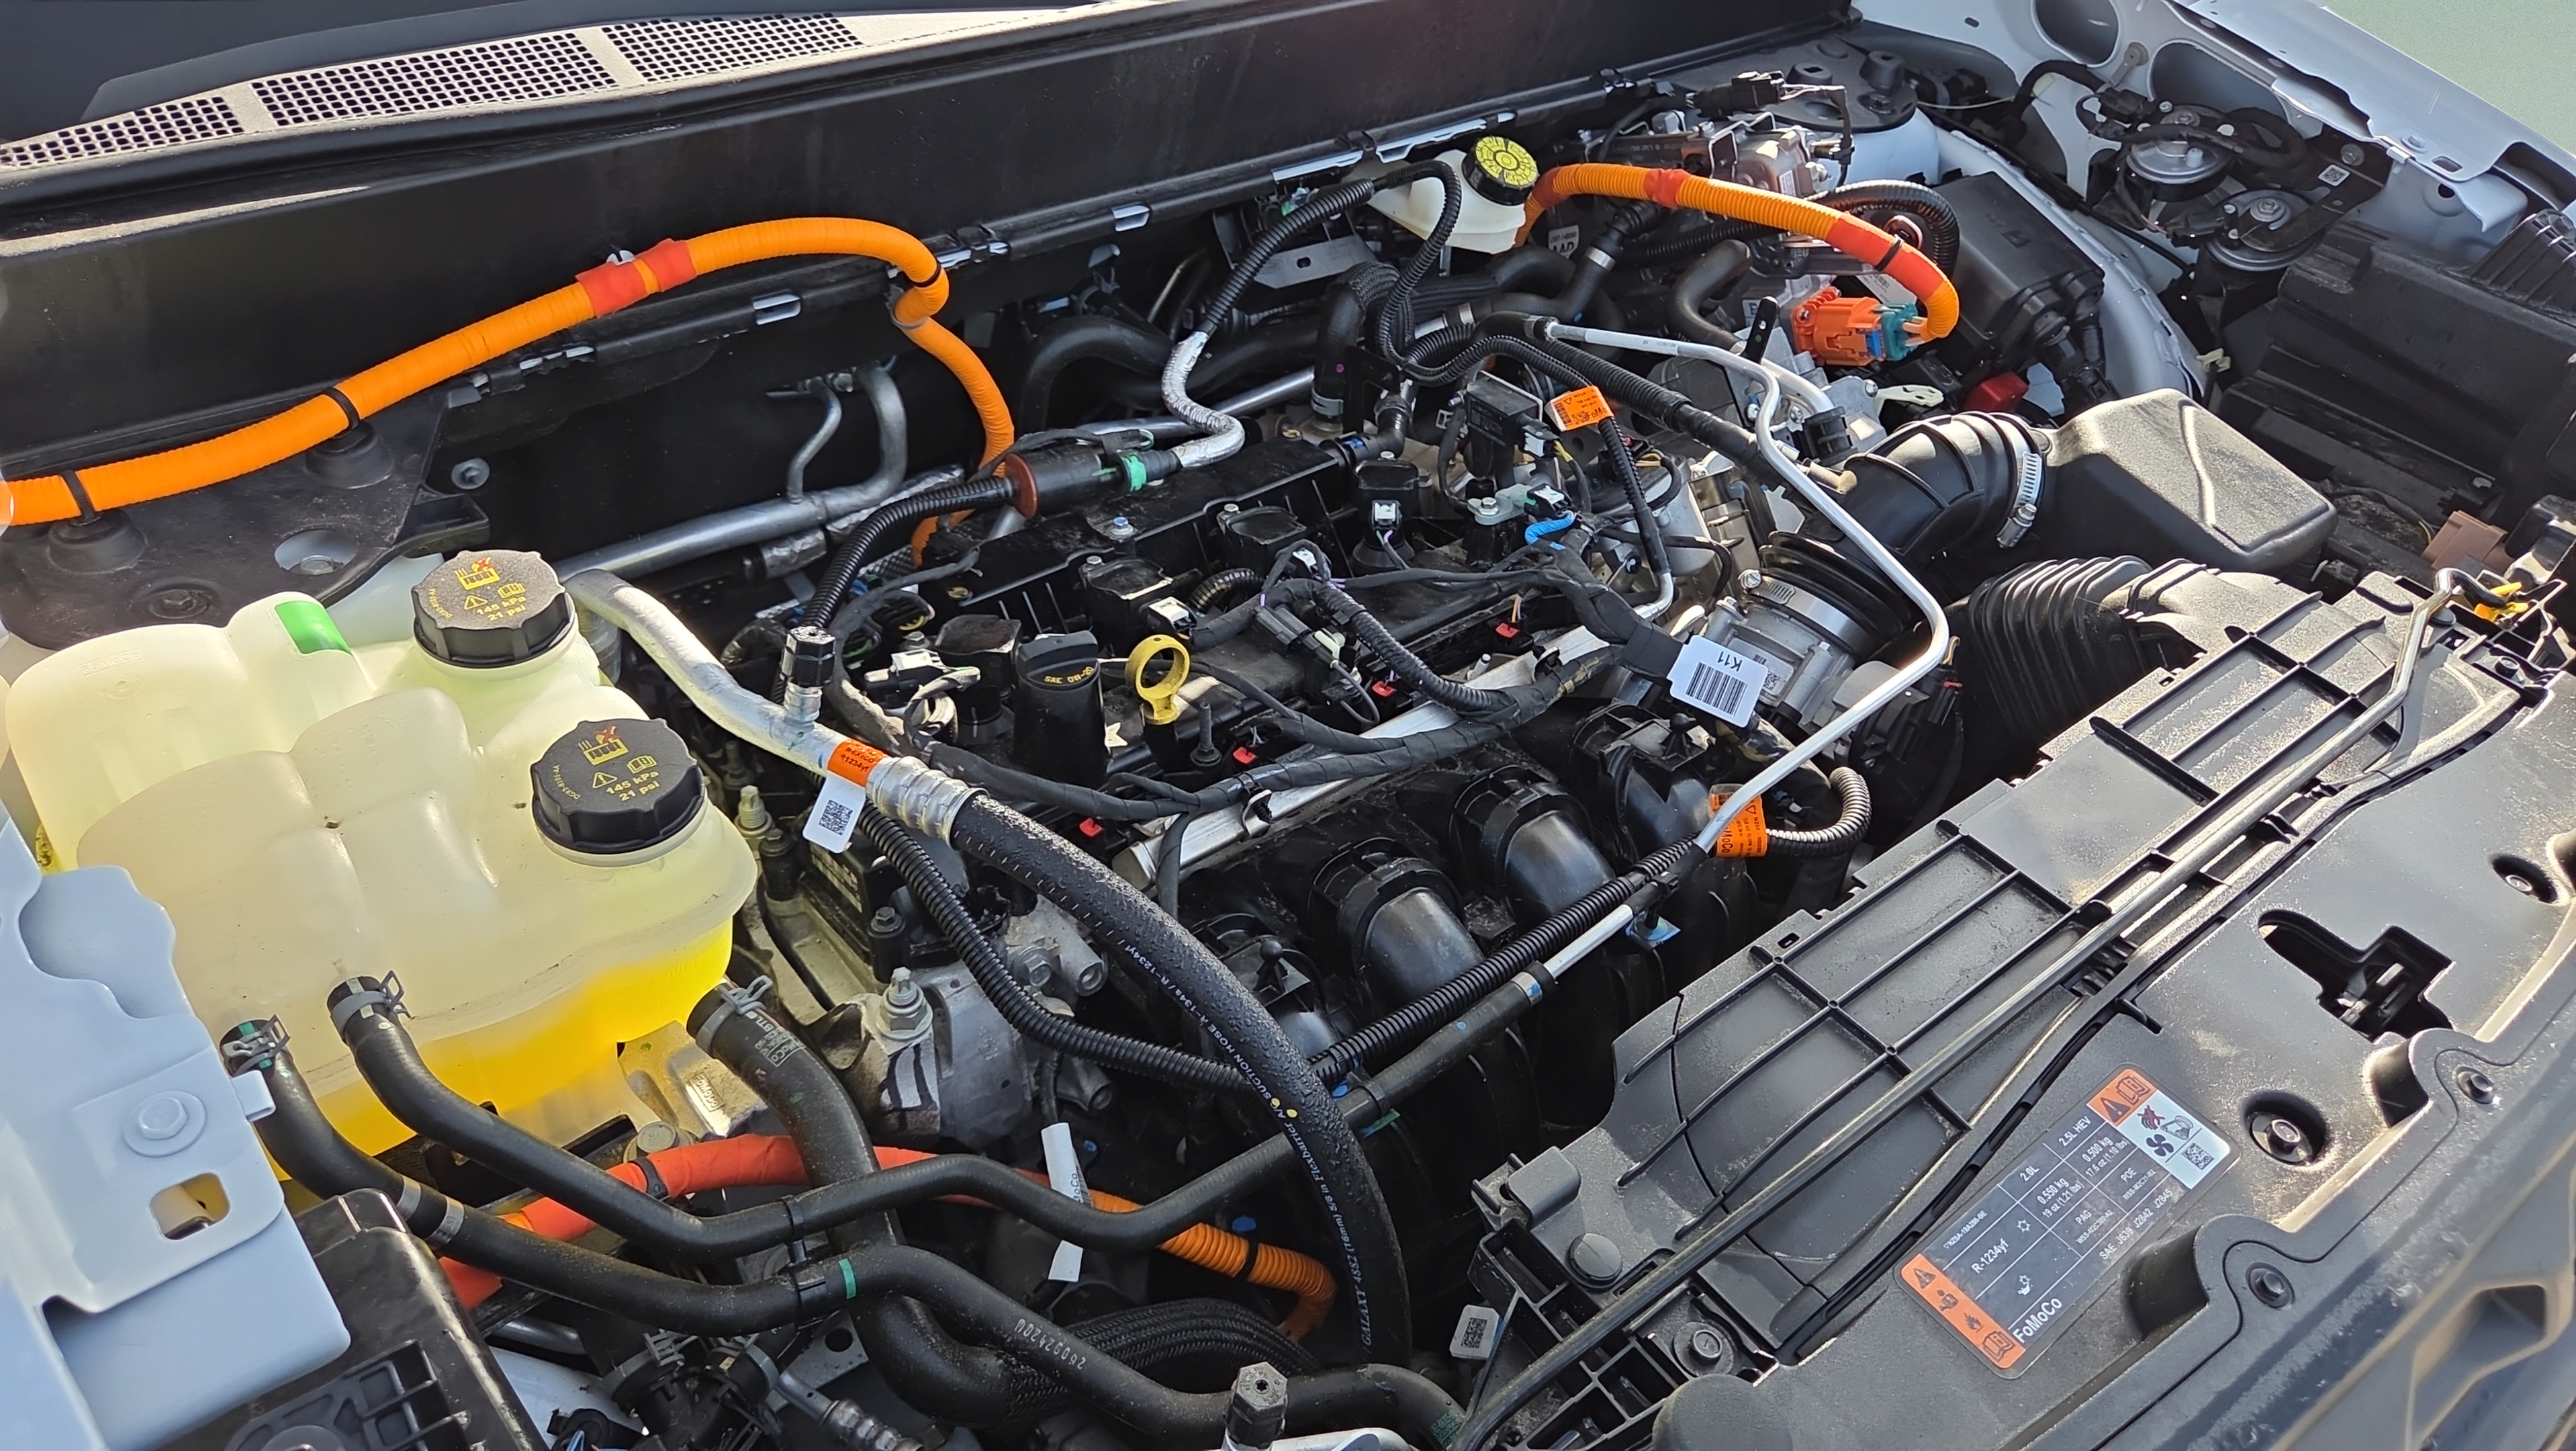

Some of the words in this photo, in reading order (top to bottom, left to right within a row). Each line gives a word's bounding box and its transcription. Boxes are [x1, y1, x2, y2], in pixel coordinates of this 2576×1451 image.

[476, 603, 499, 616] 145
[502, 595, 526, 607] kPa
[487, 612, 503, 622] 21
[507, 605, 526, 616] psi
[1716, 650, 1743, 672] K11
[1044, 675, 1063, 685] SAE
[845, 746, 879, 765] MEXICO
[606, 780, 631, 795] 145
[634, 770, 659, 783] kPa
[618, 790, 636, 801] 21
[640, 782, 659, 795] psi
[1125, 945, 1169, 985] R-1234yf
[755, 1016, 774, 1032] BTL
[1207, 1024, 1235, 1053] HOSE
[1234, 1054, 1271, 1098] SUCTION
[694, 1074, 719, 1109] FoMoCo
[2058, 1131, 2077, 1146] 2.5L
[2072, 1115, 2090, 1133] HEV
[1284, 1123, 1324, 1180] Flexbarrier
[2082, 1143, 2103, 1161] 0.500
[2097, 1136, 2113, 1150] kg
[2085, 1163, 2100, 1177] 17.6
[2097, 1158, 2107, 1167] oz
[2103, 1146, 2119, 1162] (1.10
[2114, 1137, 2130, 1149] lbs)
[2019, 1166, 2039, 1181] 2.0L
[2120, 1167, 2137, 1182] POE
[1324, 1195, 1337, 1211] 5/8
[2037, 1184, 2058, 1204] 0.550
[2053, 1177, 2069, 1191] kg
[2041, 1208, 2052, 1218] 19
[2050, 1202, 2060, 1212] oz
[2068, 1180, 2084, 1193] lbs)
[2075, 1209, 2092, 1225] PAG
[2099, 1243, 2117, 1260] SAE
[2116, 1227, 2133, 1244] J639
[2133, 1208, 2153, 1228] J2842
[2153, 1188, 2174, 1208] J2845
[1332, 1214, 1354, 1251] (16mm)
[1971, 1238, 2008, 1273] R-1234yf
[2013, 1296, 2063, 1344] FoMoCo
